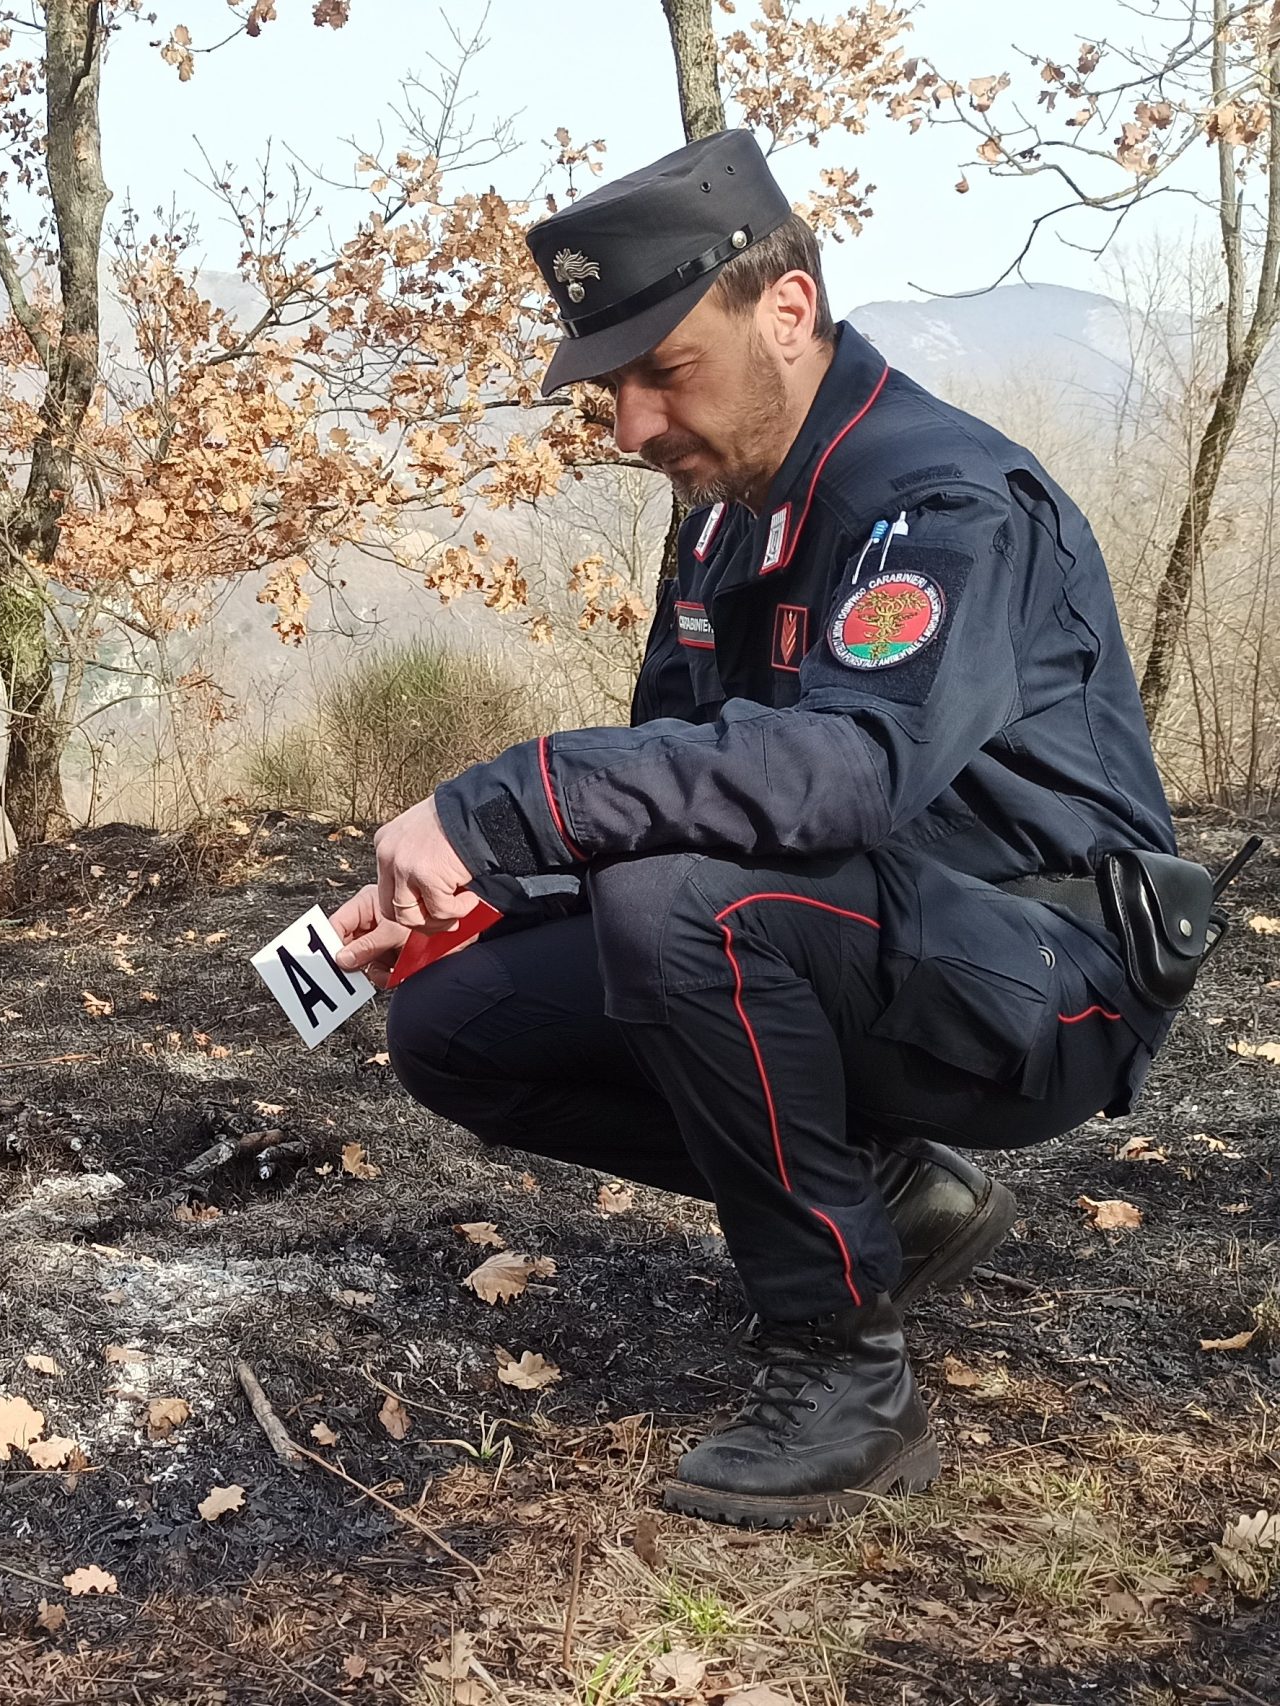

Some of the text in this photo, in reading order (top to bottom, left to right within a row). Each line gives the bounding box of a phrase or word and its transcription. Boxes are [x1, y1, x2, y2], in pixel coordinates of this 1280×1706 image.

[868, 573, 928, 588] CARABINIERI
[838, 587, 867, 619] COMANDO
[678, 615, 715, 638] CARABINIER
[276, 923, 357, 1029] A1
